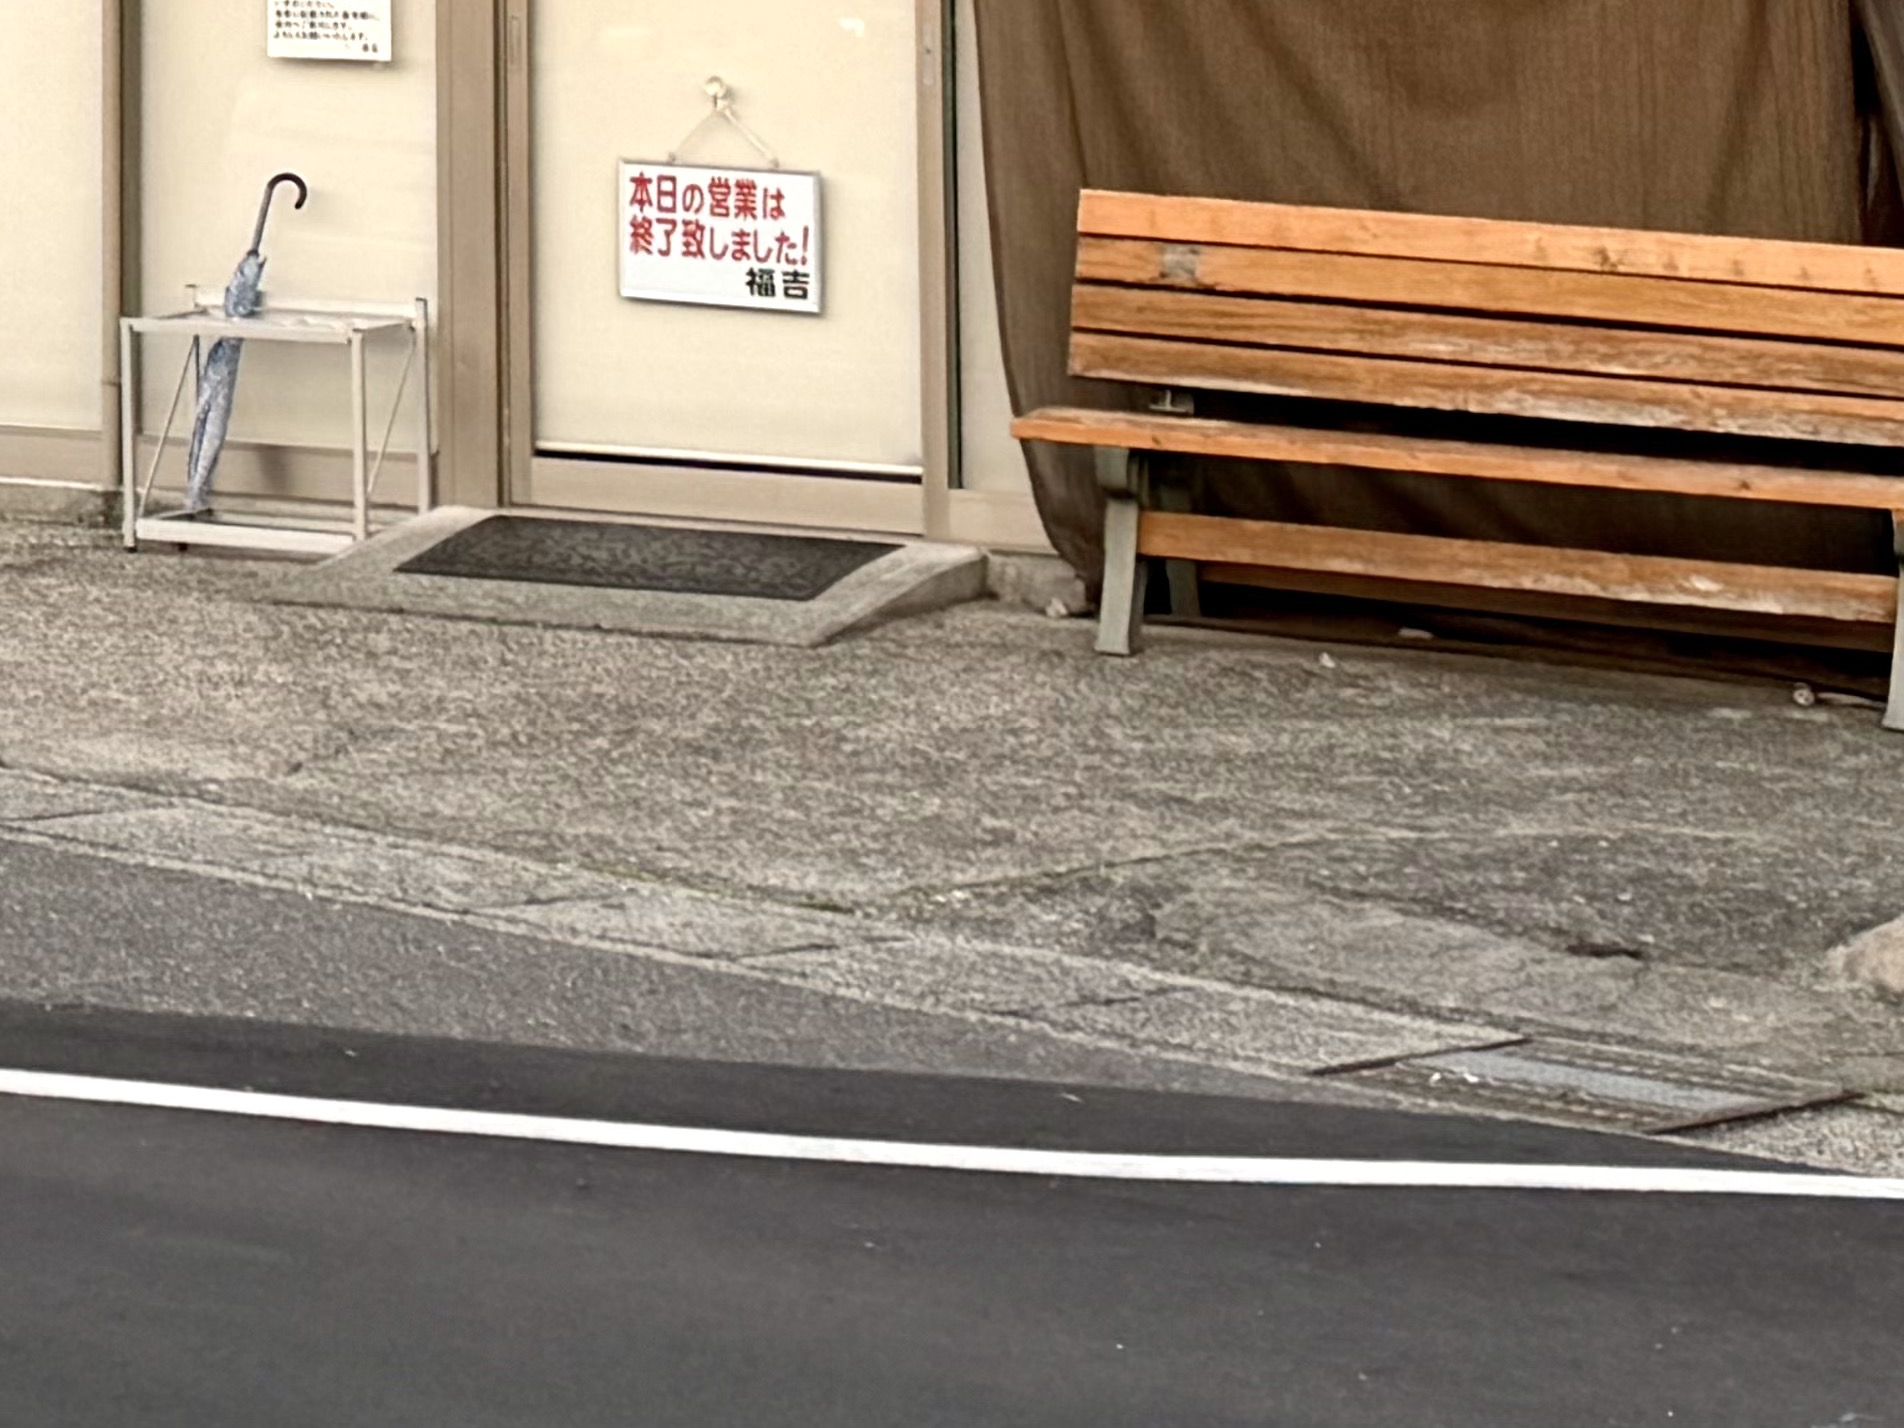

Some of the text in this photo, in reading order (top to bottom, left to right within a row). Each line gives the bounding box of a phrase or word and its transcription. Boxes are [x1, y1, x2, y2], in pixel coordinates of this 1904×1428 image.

[628, 171, 786, 221] 本日の営業は
[628, 214, 810, 266] 終了致しました!
[745, 267, 811, 301] 福吉
